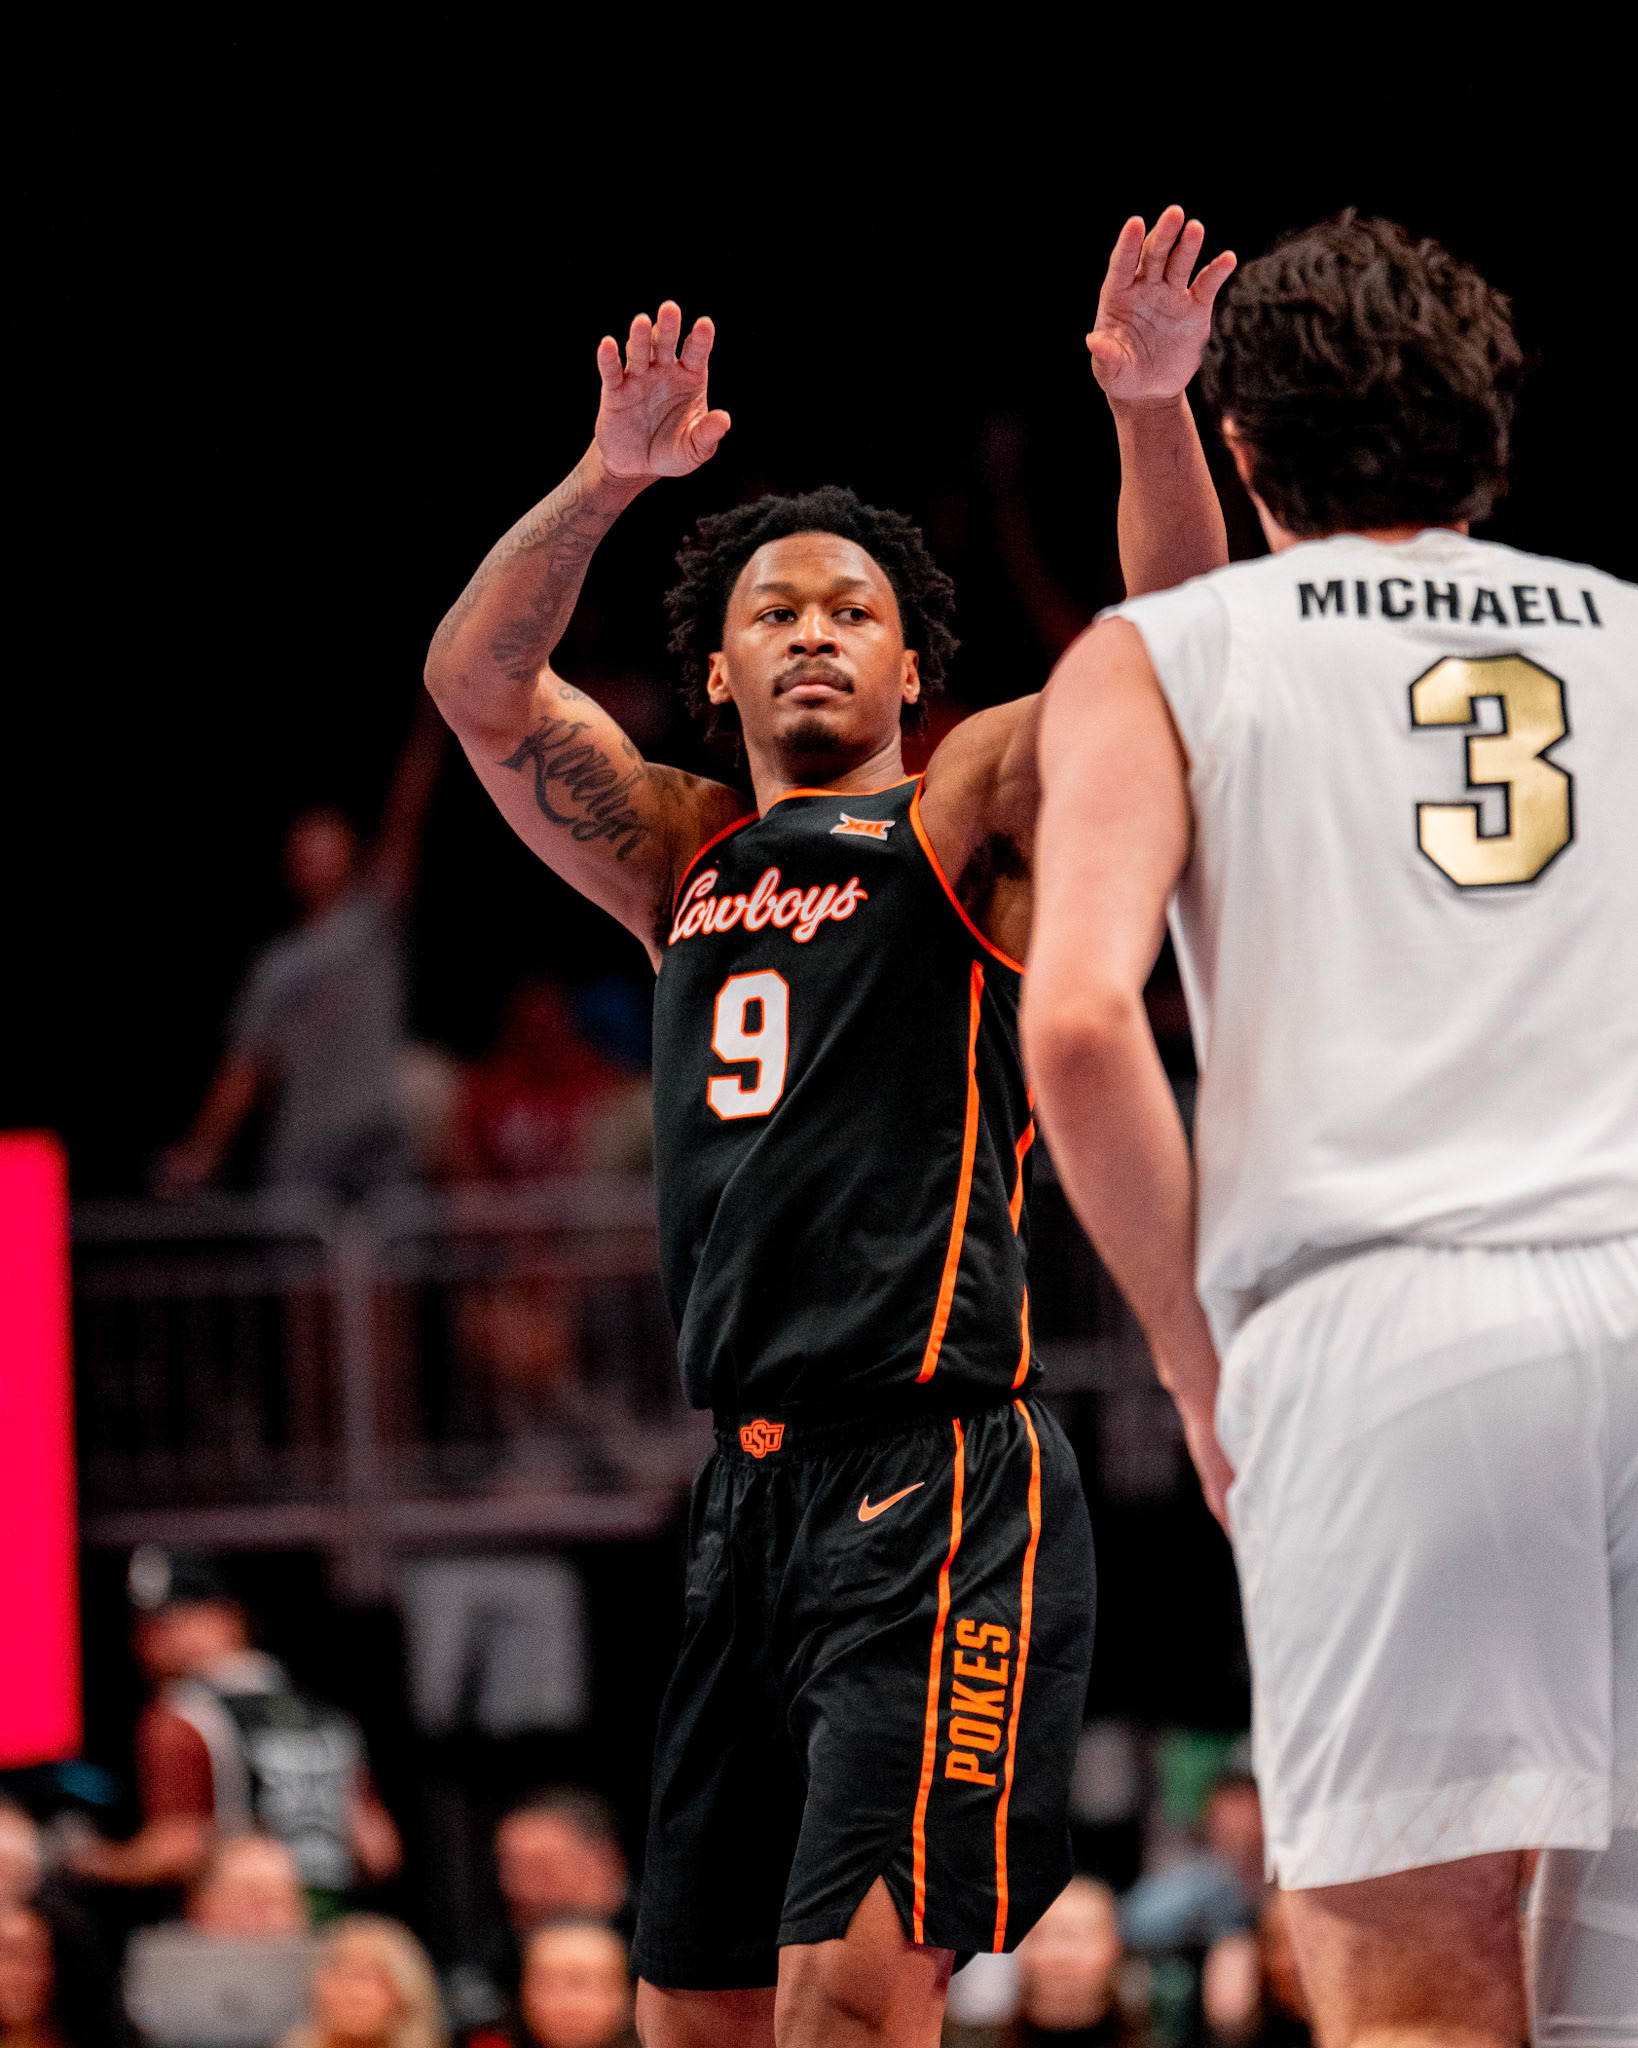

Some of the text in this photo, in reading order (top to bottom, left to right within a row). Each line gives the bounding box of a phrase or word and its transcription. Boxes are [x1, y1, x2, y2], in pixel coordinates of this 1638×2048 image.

[1297, 577, 1603, 627] MICHAELI
[1408, 653, 1575, 887] 3
[668, 867, 868, 945] Cowboys
[707, 969, 789, 1120] 9
[739, 1419, 785, 1459] OSU
[945, 1618, 1011, 1787] POKES
